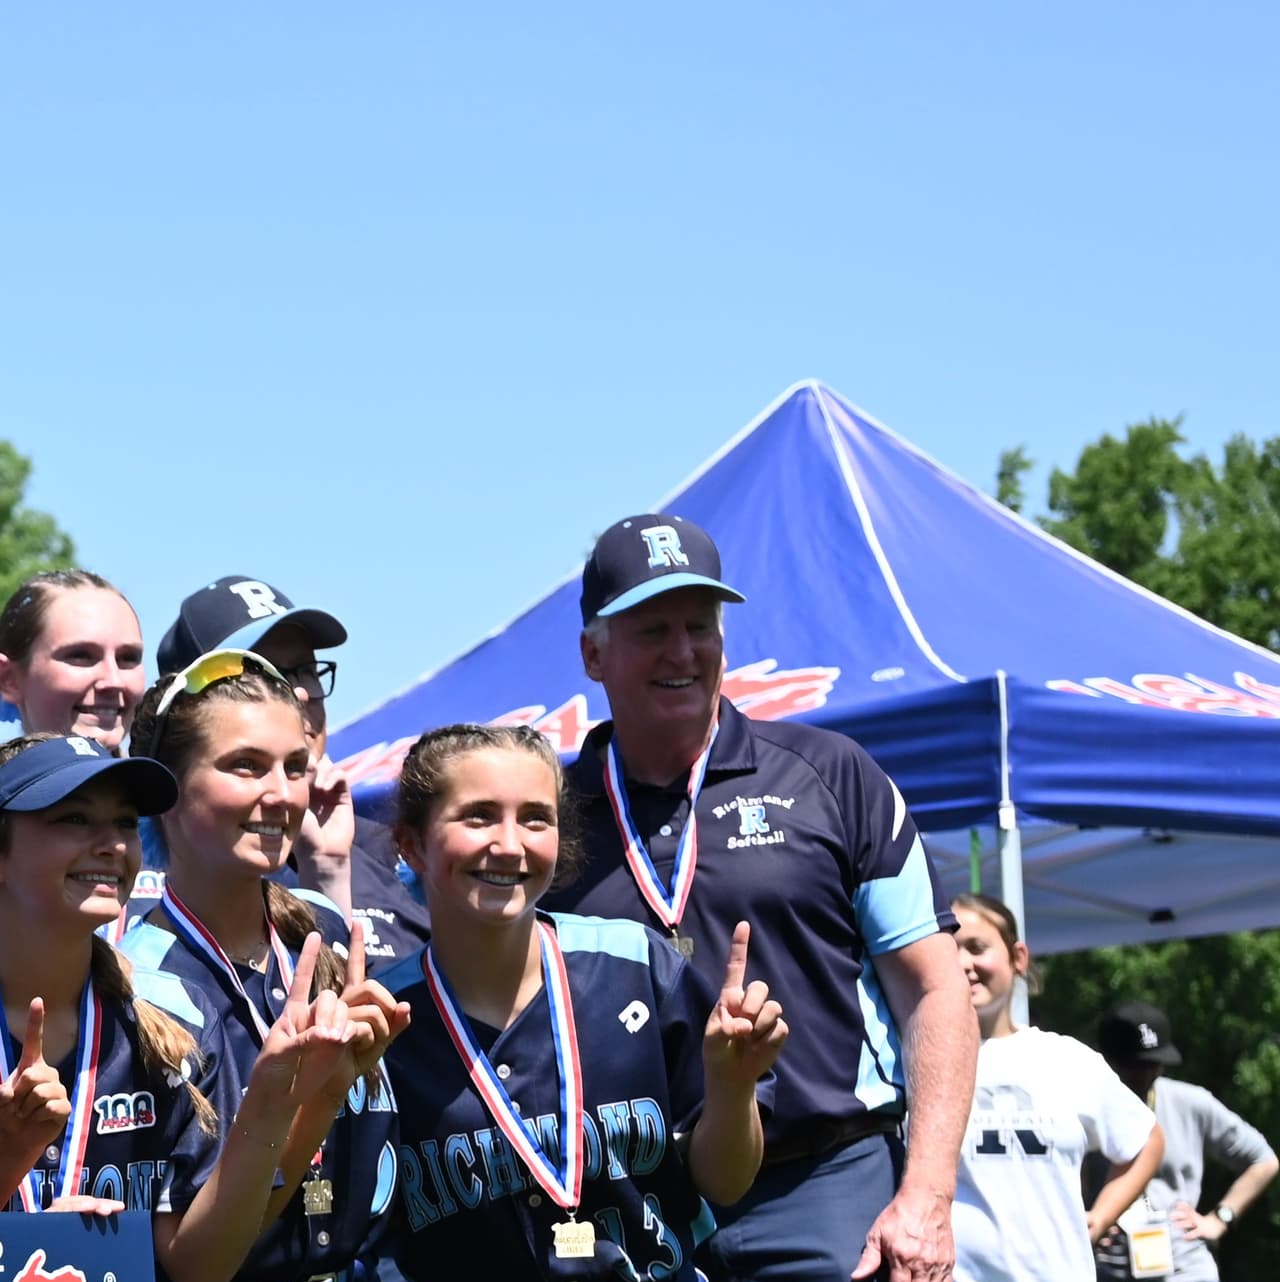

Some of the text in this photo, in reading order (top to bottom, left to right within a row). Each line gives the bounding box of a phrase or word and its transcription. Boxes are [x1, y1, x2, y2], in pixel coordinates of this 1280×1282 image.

[639, 525, 689, 568] R
[228, 580, 288, 619] R
[712, 796, 796, 819] Richmond
[738, 804, 771, 836] R
[726, 830, 786, 850] Softball
